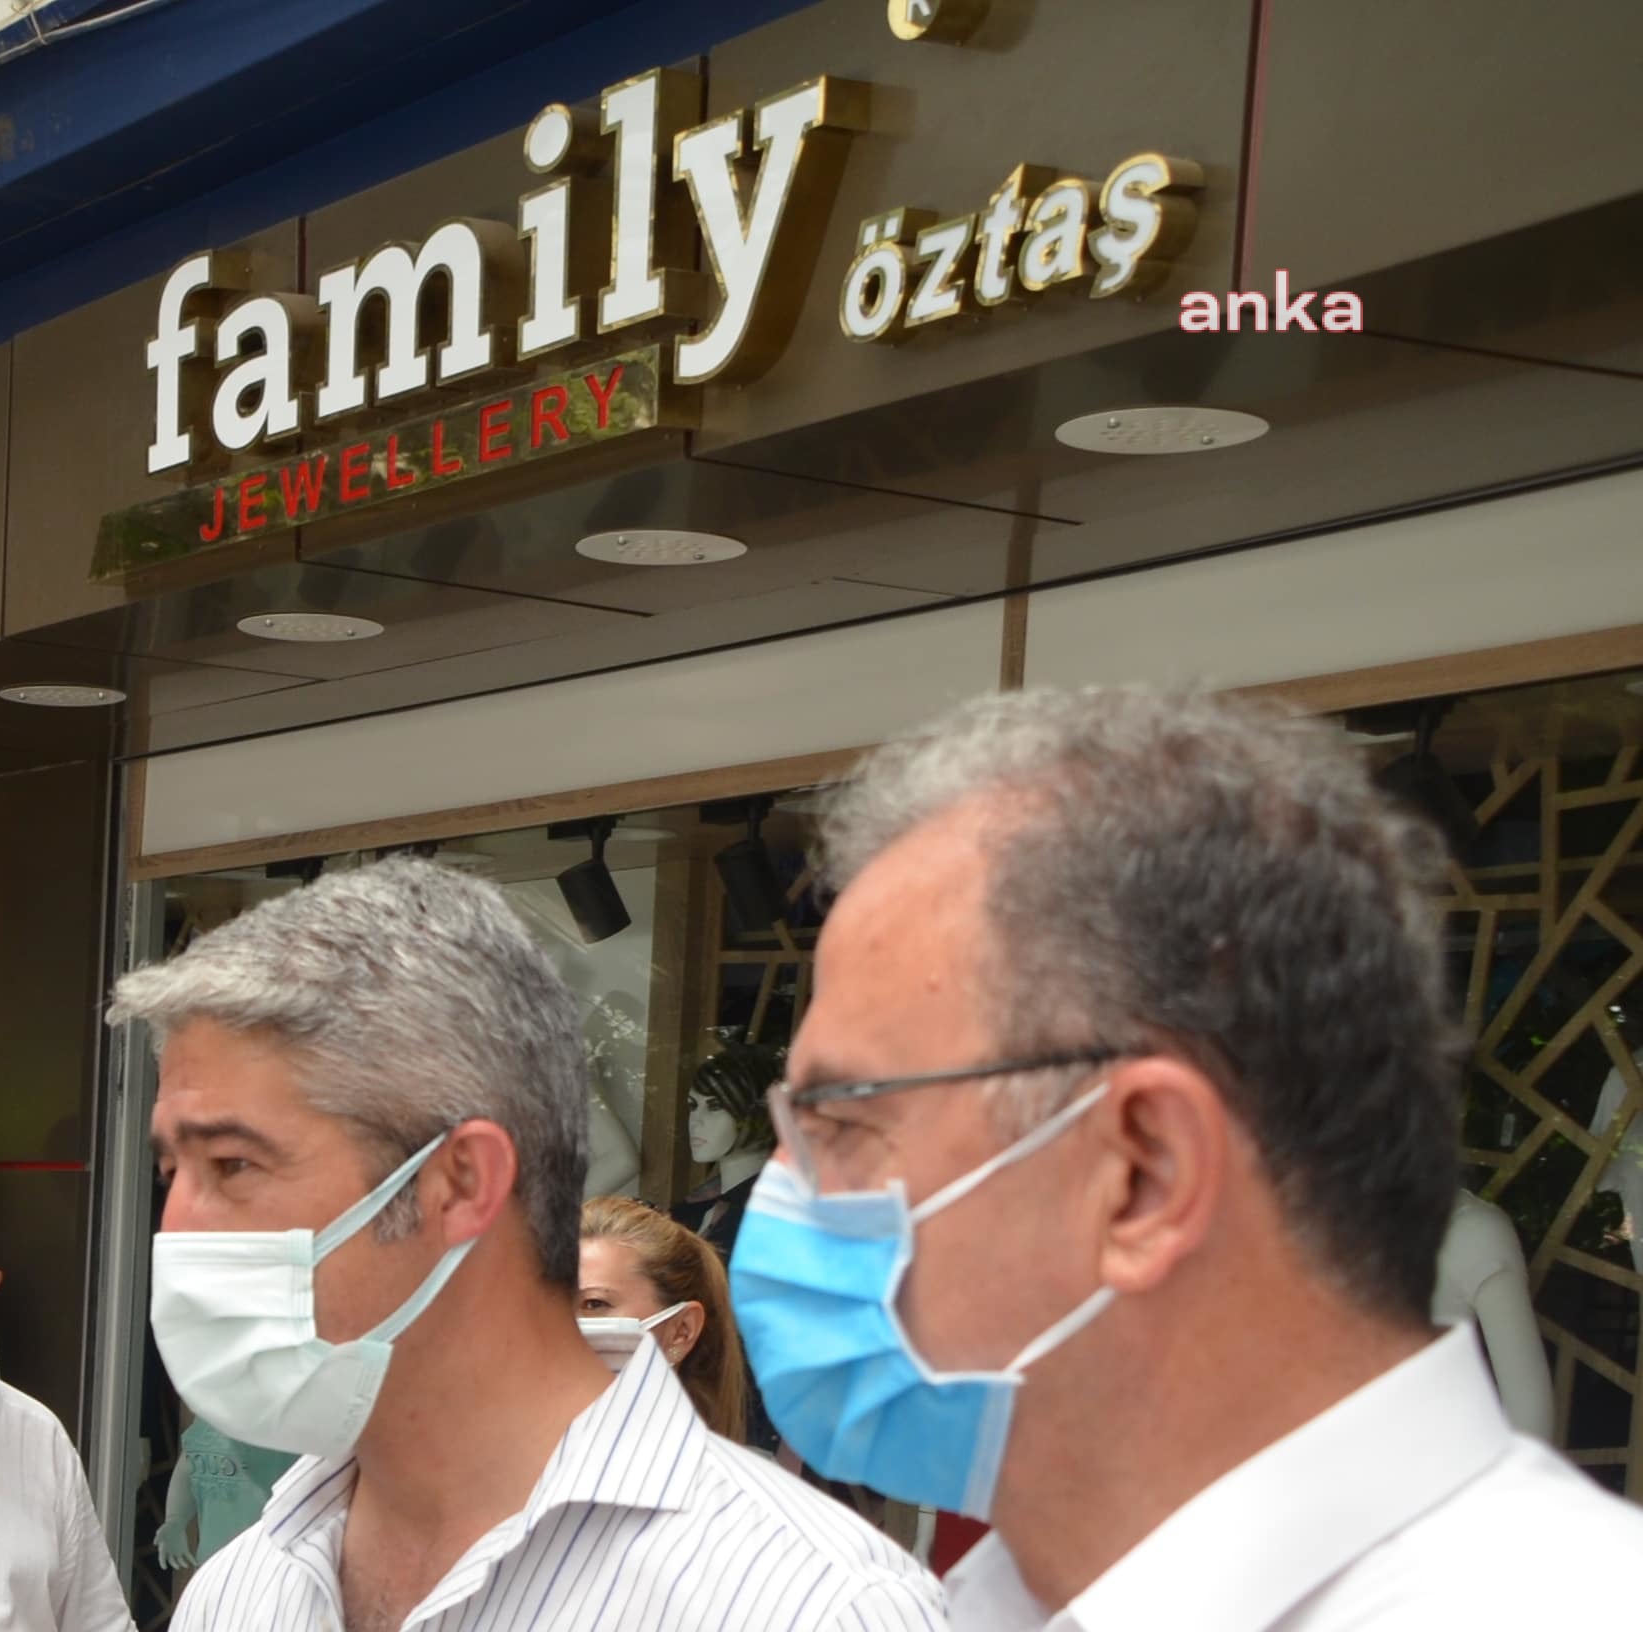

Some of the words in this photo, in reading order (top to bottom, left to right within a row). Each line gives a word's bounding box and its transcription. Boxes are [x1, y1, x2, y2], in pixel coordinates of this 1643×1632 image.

[146, 66, 827, 474] family
[839, 152, 1172, 343] öztaş
[199, 364, 627, 543] JEWELLERY
